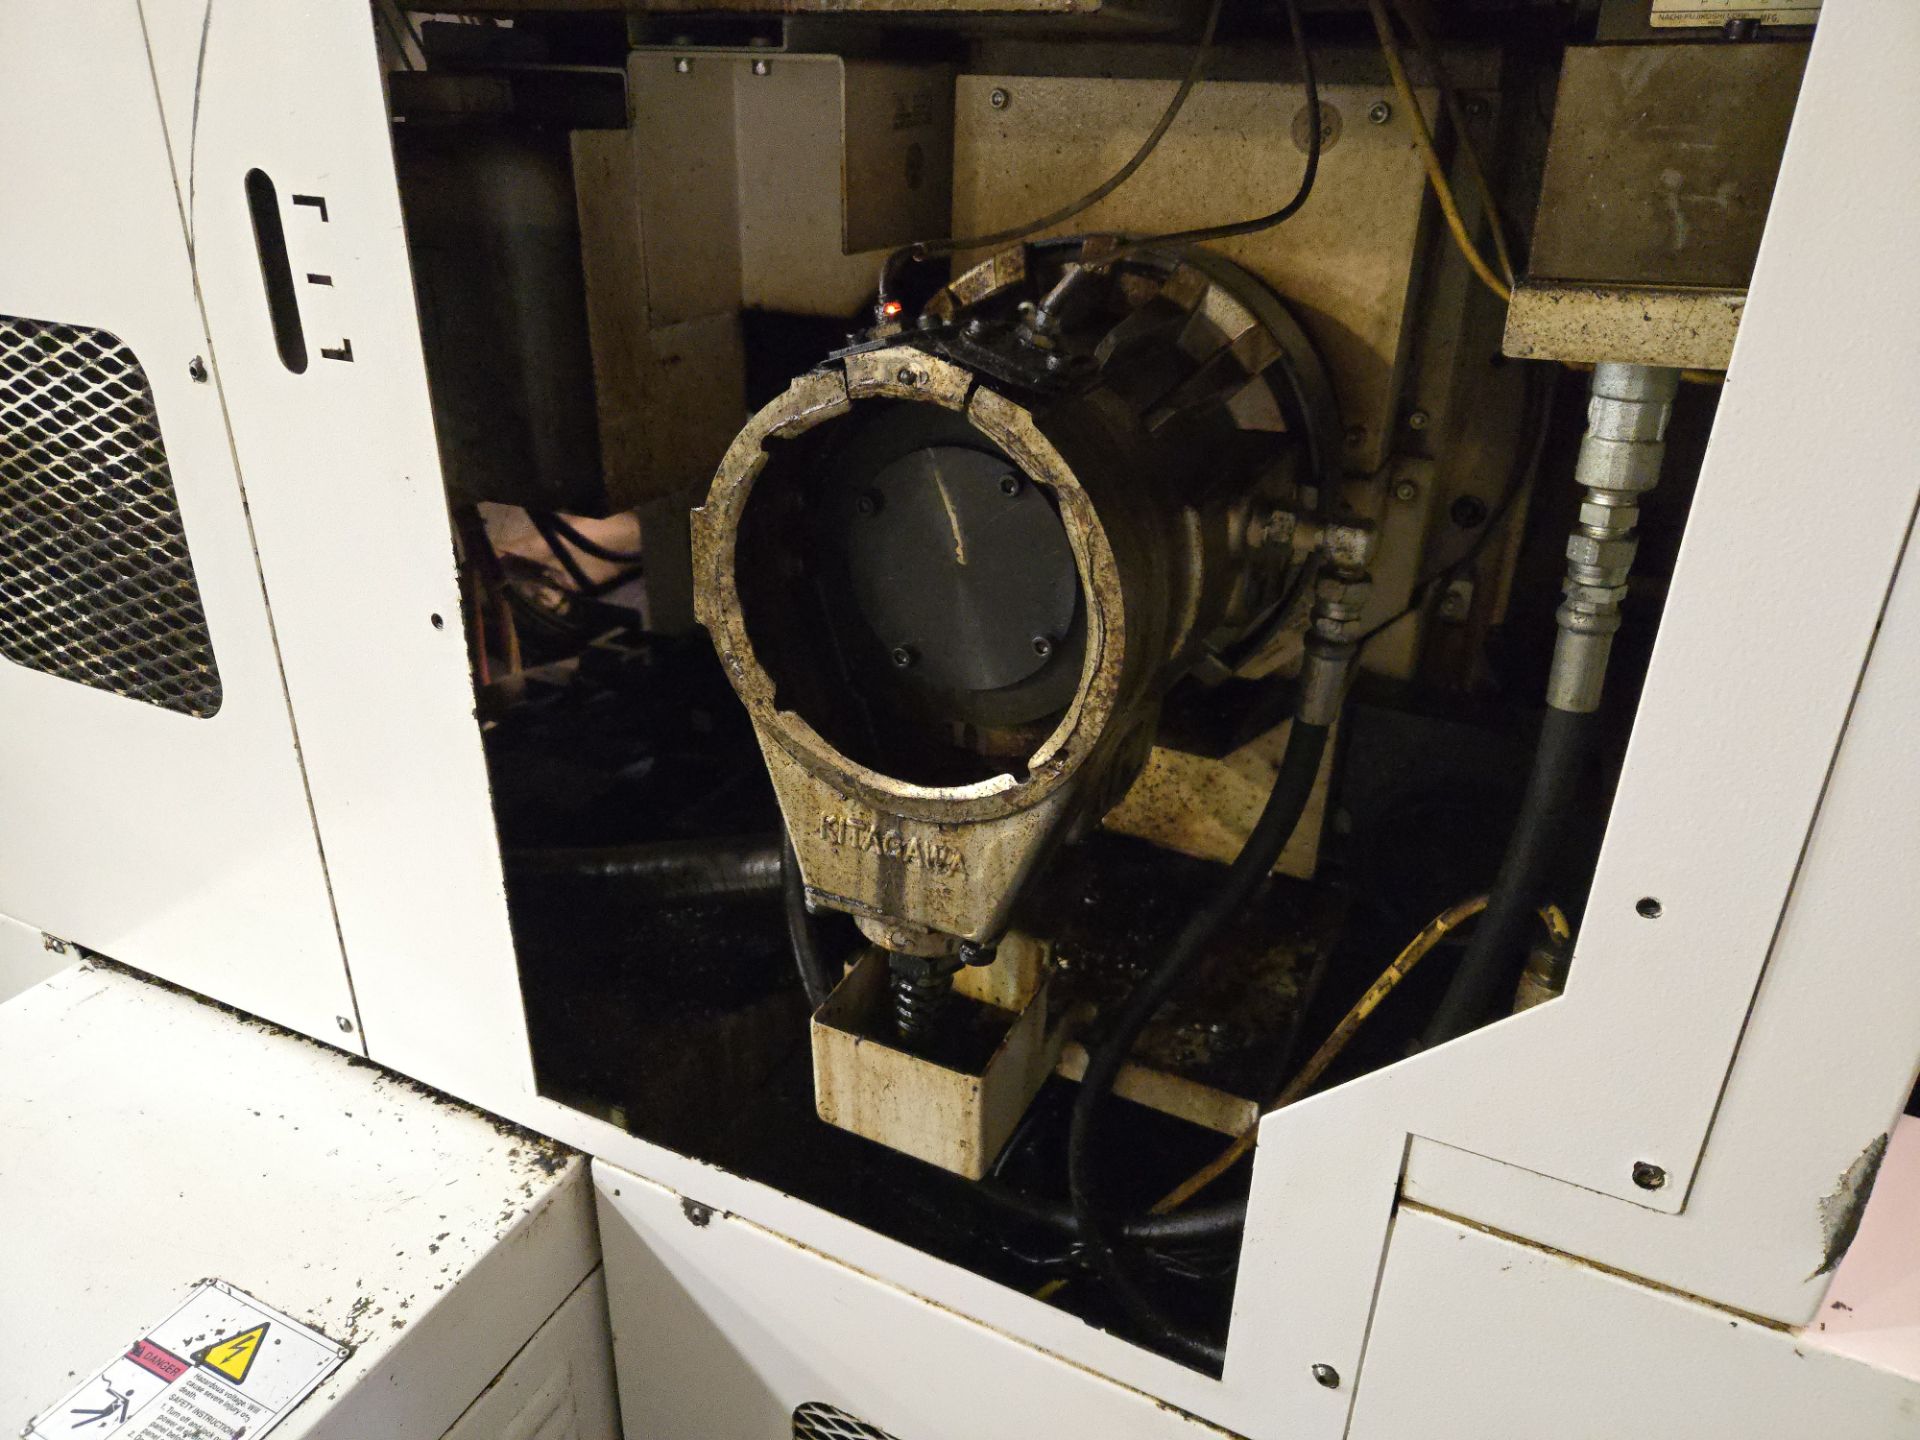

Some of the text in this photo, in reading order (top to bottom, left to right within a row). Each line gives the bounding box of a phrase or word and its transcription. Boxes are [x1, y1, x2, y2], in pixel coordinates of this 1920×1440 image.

[819, 813, 968, 881] KITAGAWA
[144, 1351, 181, 1376] DANGER
[194, 1373, 225, 1394] Hazardous
[168, 1394, 193, 1411] SAFETY
[186, 1380, 204, 1393] cause
[204, 1390, 224, 1404] severe
[223, 1400, 241, 1415] injury
[166, 1406, 181, 1418] Turn
[180, 1415, 191, 1423] off
